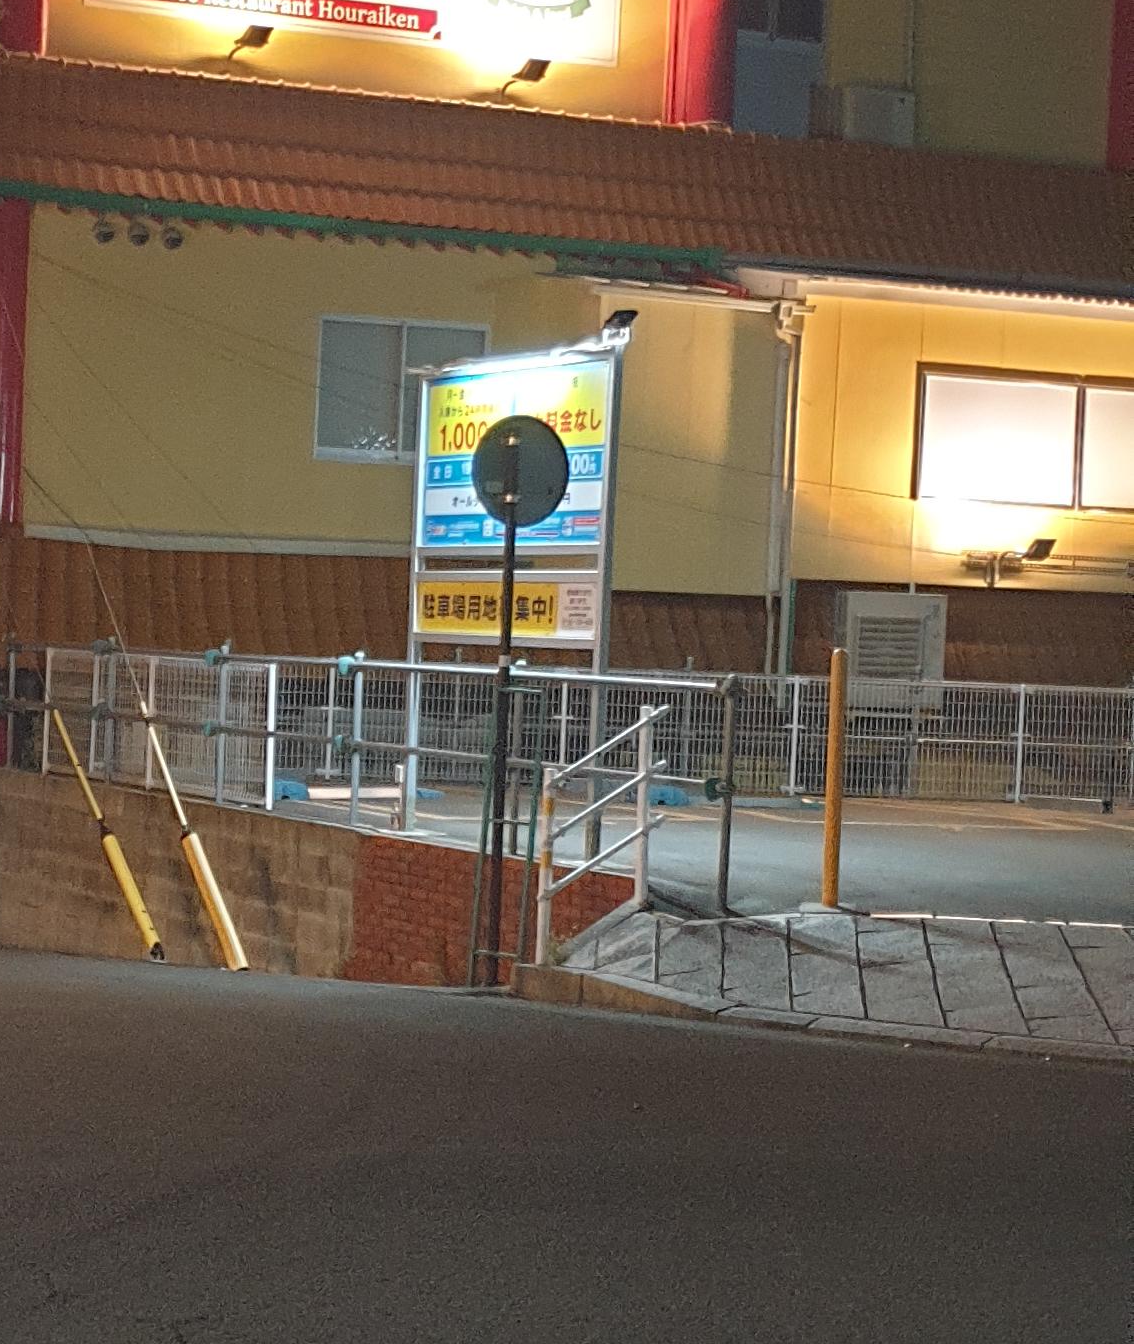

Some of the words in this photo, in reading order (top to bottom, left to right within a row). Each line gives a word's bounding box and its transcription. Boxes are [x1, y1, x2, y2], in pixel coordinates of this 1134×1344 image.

[317, 0, 420, 31] Houraiken
[535, 407, 602, 434] 料金なし
[422, 593, 555, 625] 駐車場用地集中!
